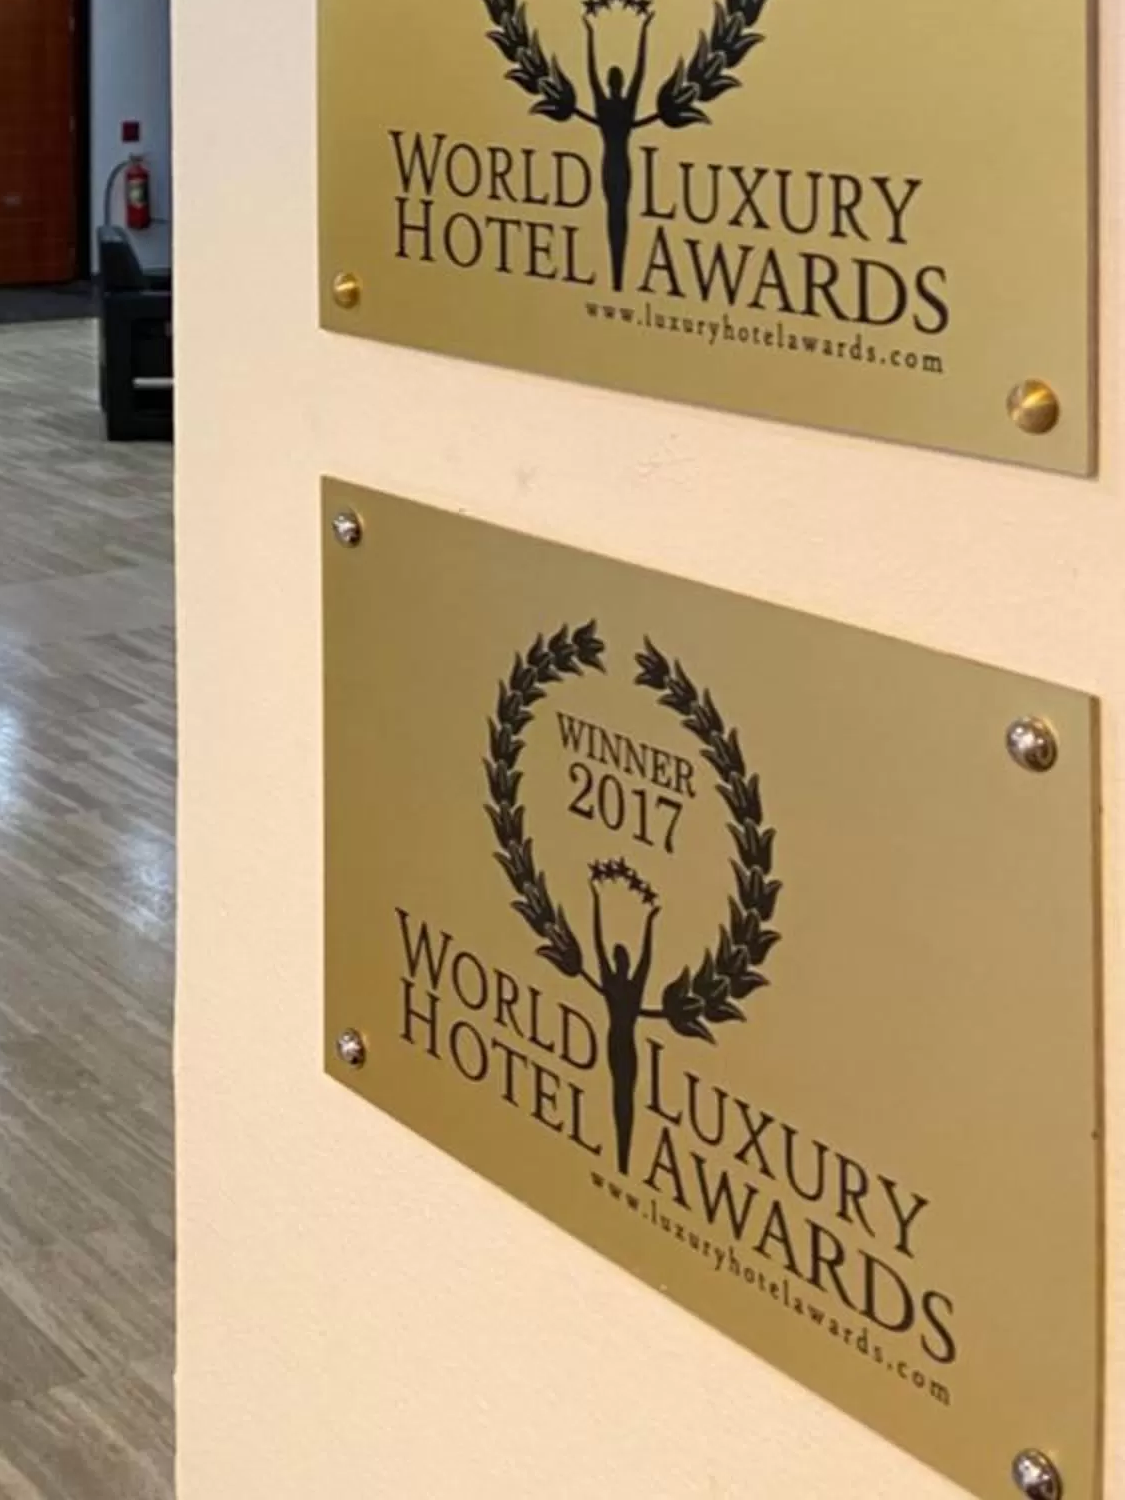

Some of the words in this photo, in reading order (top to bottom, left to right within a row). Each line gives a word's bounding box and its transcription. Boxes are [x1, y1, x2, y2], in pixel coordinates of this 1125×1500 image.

[388, 130, 592, 209] WORLD
[640, 146, 923, 245] LUXURY
[394, 196, 596, 287] HOTEL
[636, 226, 950, 335] AWARDS
[584, 300, 945, 374] www.luxuryhotelawards.com
[555, 711, 697, 799] WINNER
[567, 763, 684, 855] 2017
[395, 906, 598, 1072] WORLD
[645, 1039, 930, 1260] LUXURY
[399, 976, 603, 1157] HOTEL
[643, 1126, 958, 1366] AWARDS
[590, 1170, 952, 1407] www.luxuryhotelawards.com
